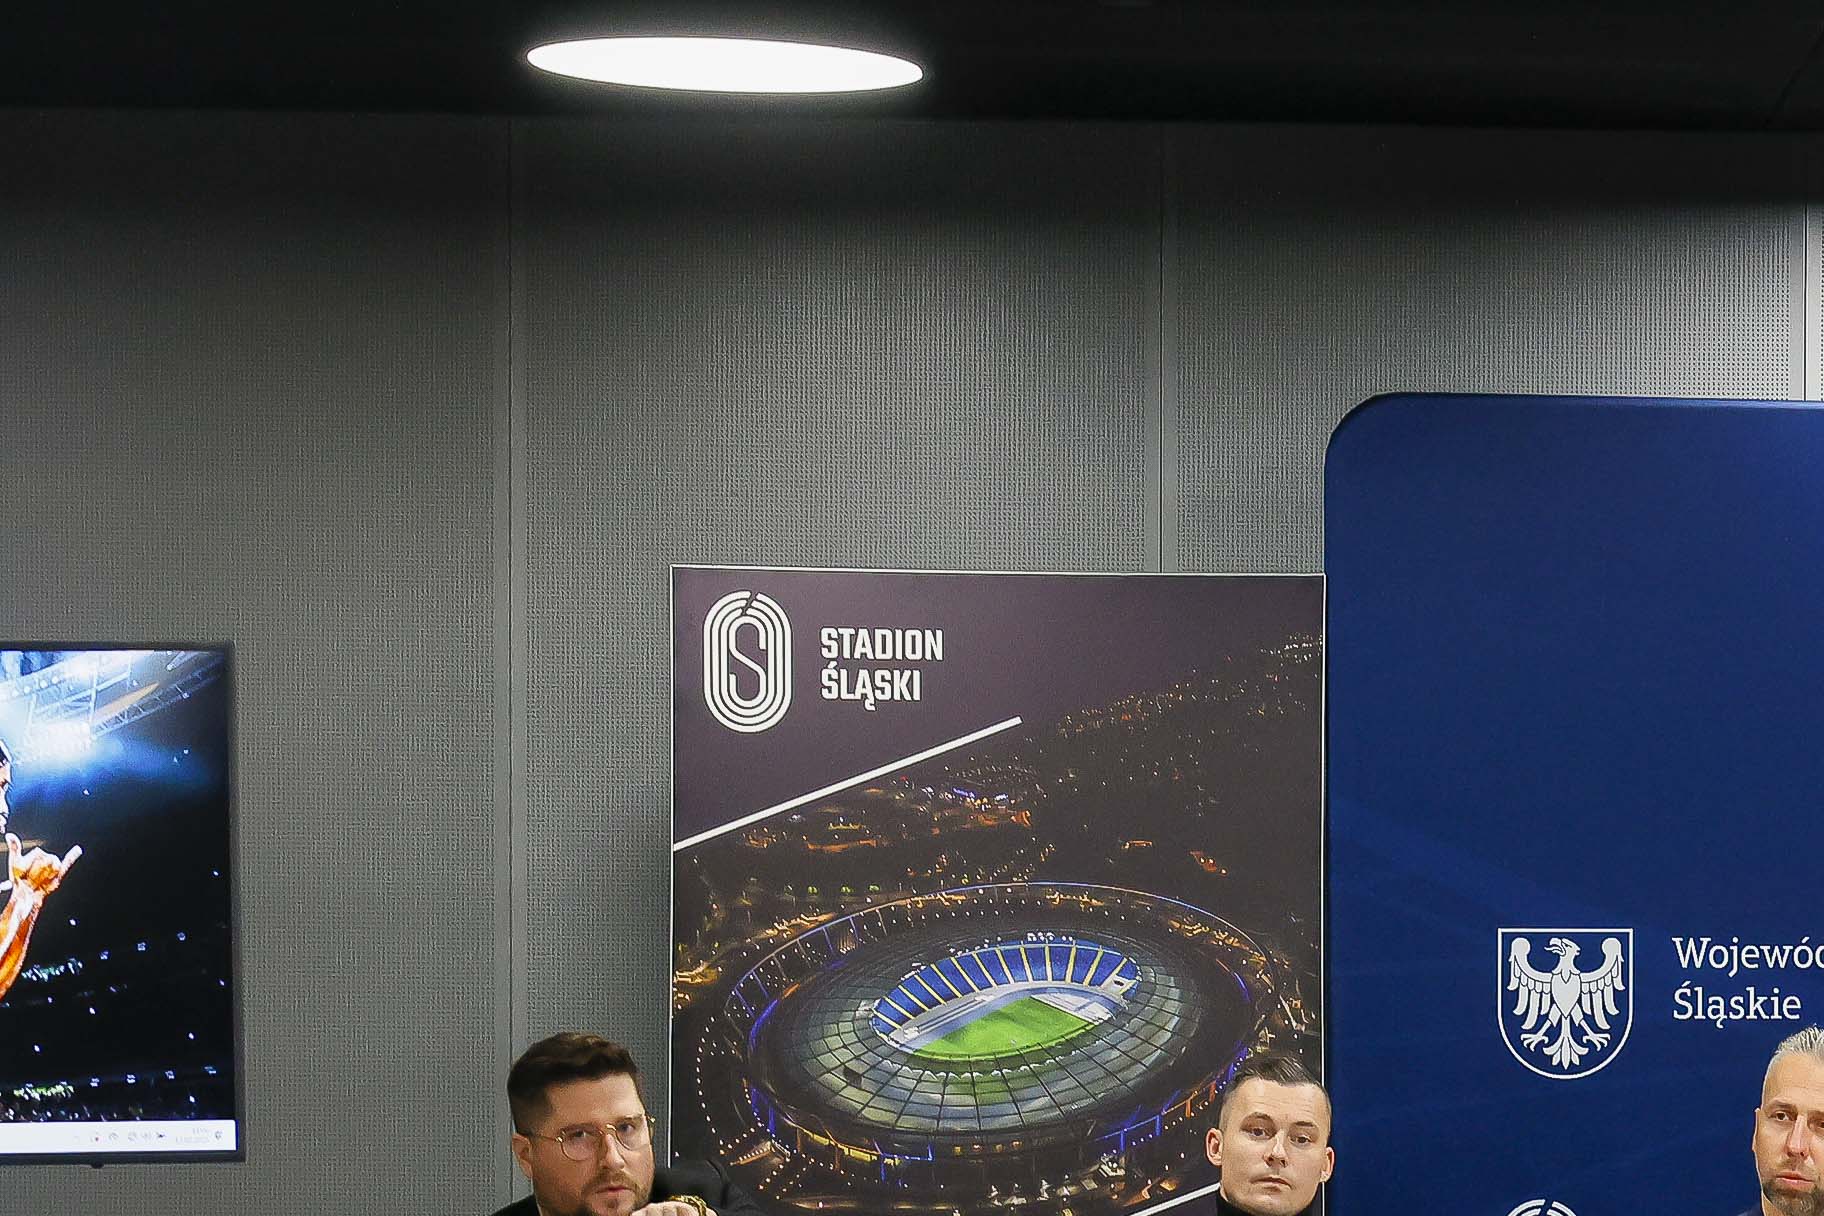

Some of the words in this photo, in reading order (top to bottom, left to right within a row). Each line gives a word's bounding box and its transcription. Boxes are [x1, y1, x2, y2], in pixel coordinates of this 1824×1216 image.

[820, 626, 943, 662] STADION
[820, 661, 921, 711] ŚLĄSKI
[1672, 986, 1802, 1028] Śląskie
